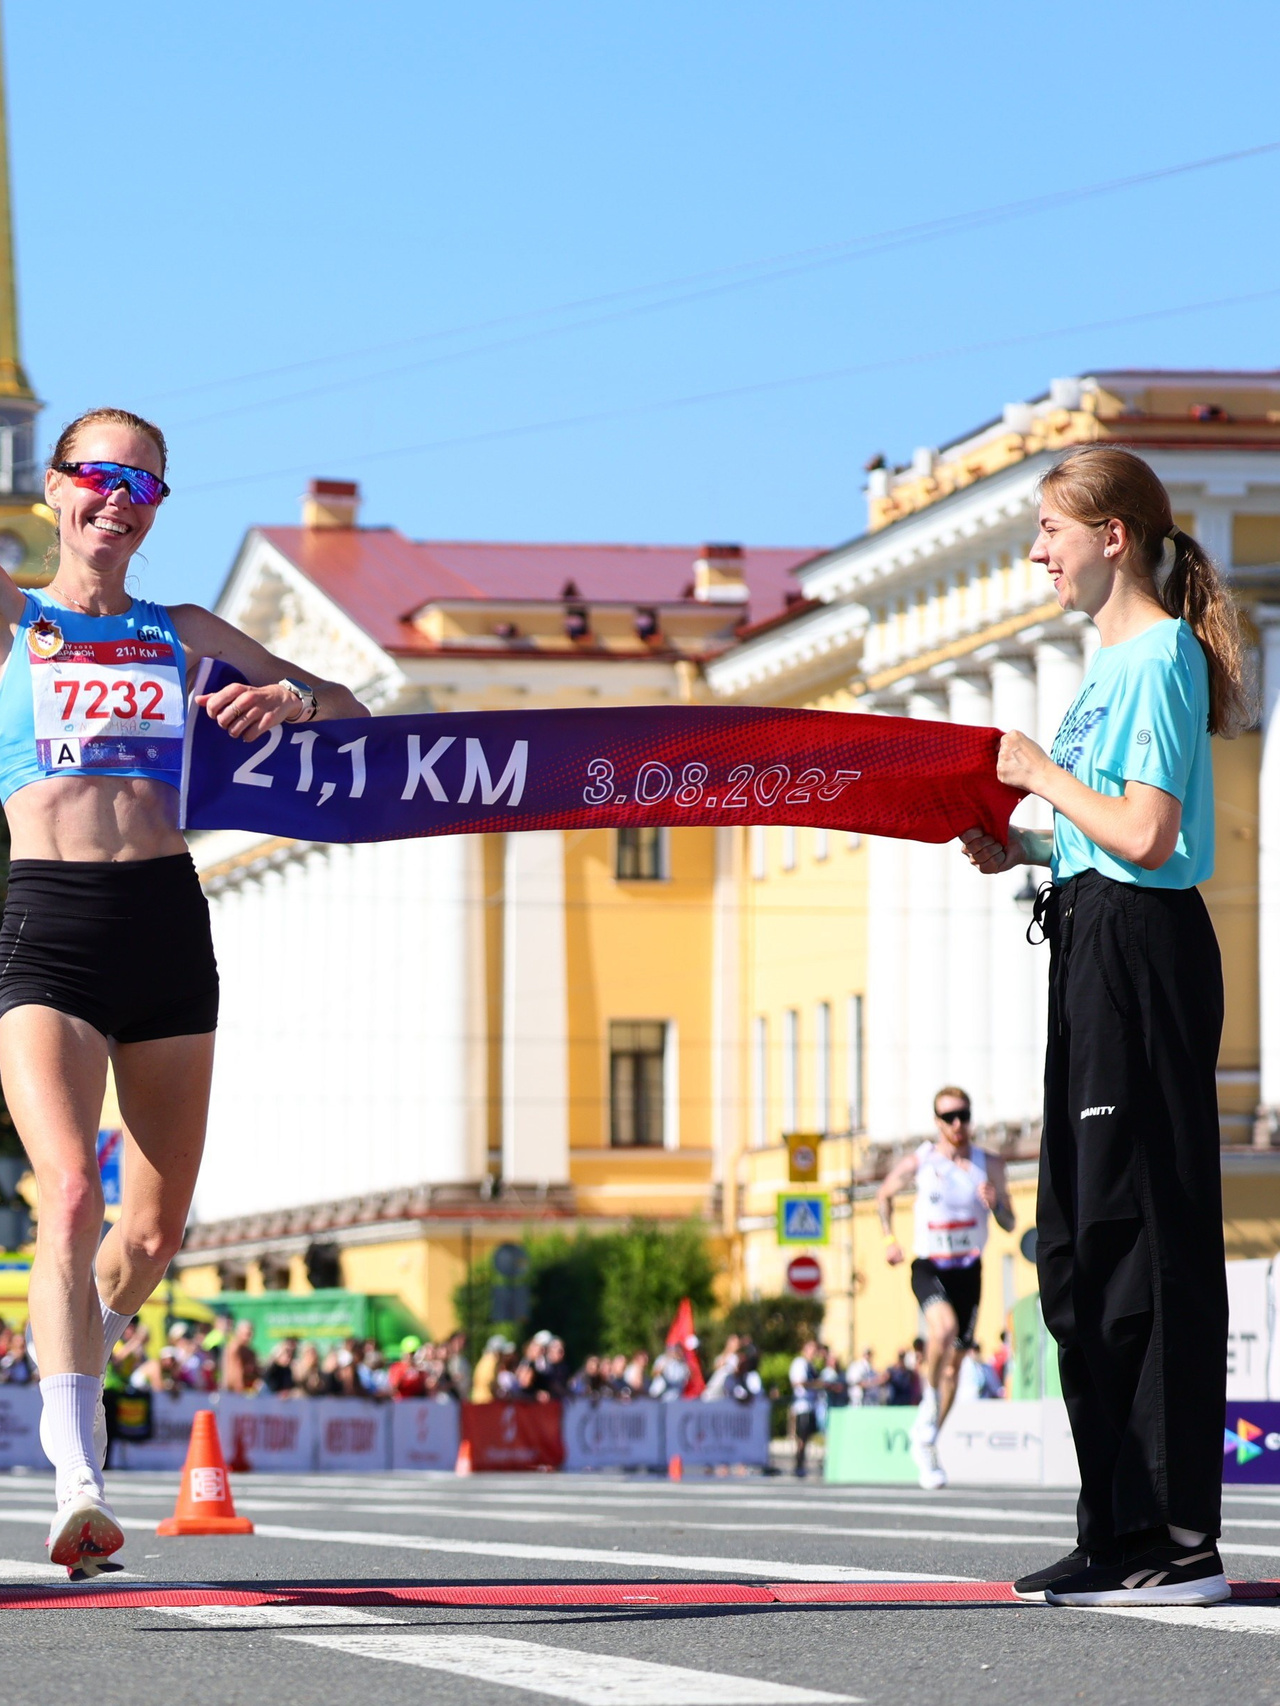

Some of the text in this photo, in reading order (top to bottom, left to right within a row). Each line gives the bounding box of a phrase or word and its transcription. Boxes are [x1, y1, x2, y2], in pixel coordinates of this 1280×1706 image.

[116, 646, 137, 657] 21,1
[54, 680, 166, 721] 7232
[232, 724, 367, 806] 21,1
[583, 757, 860, 809] 3.08.2025
